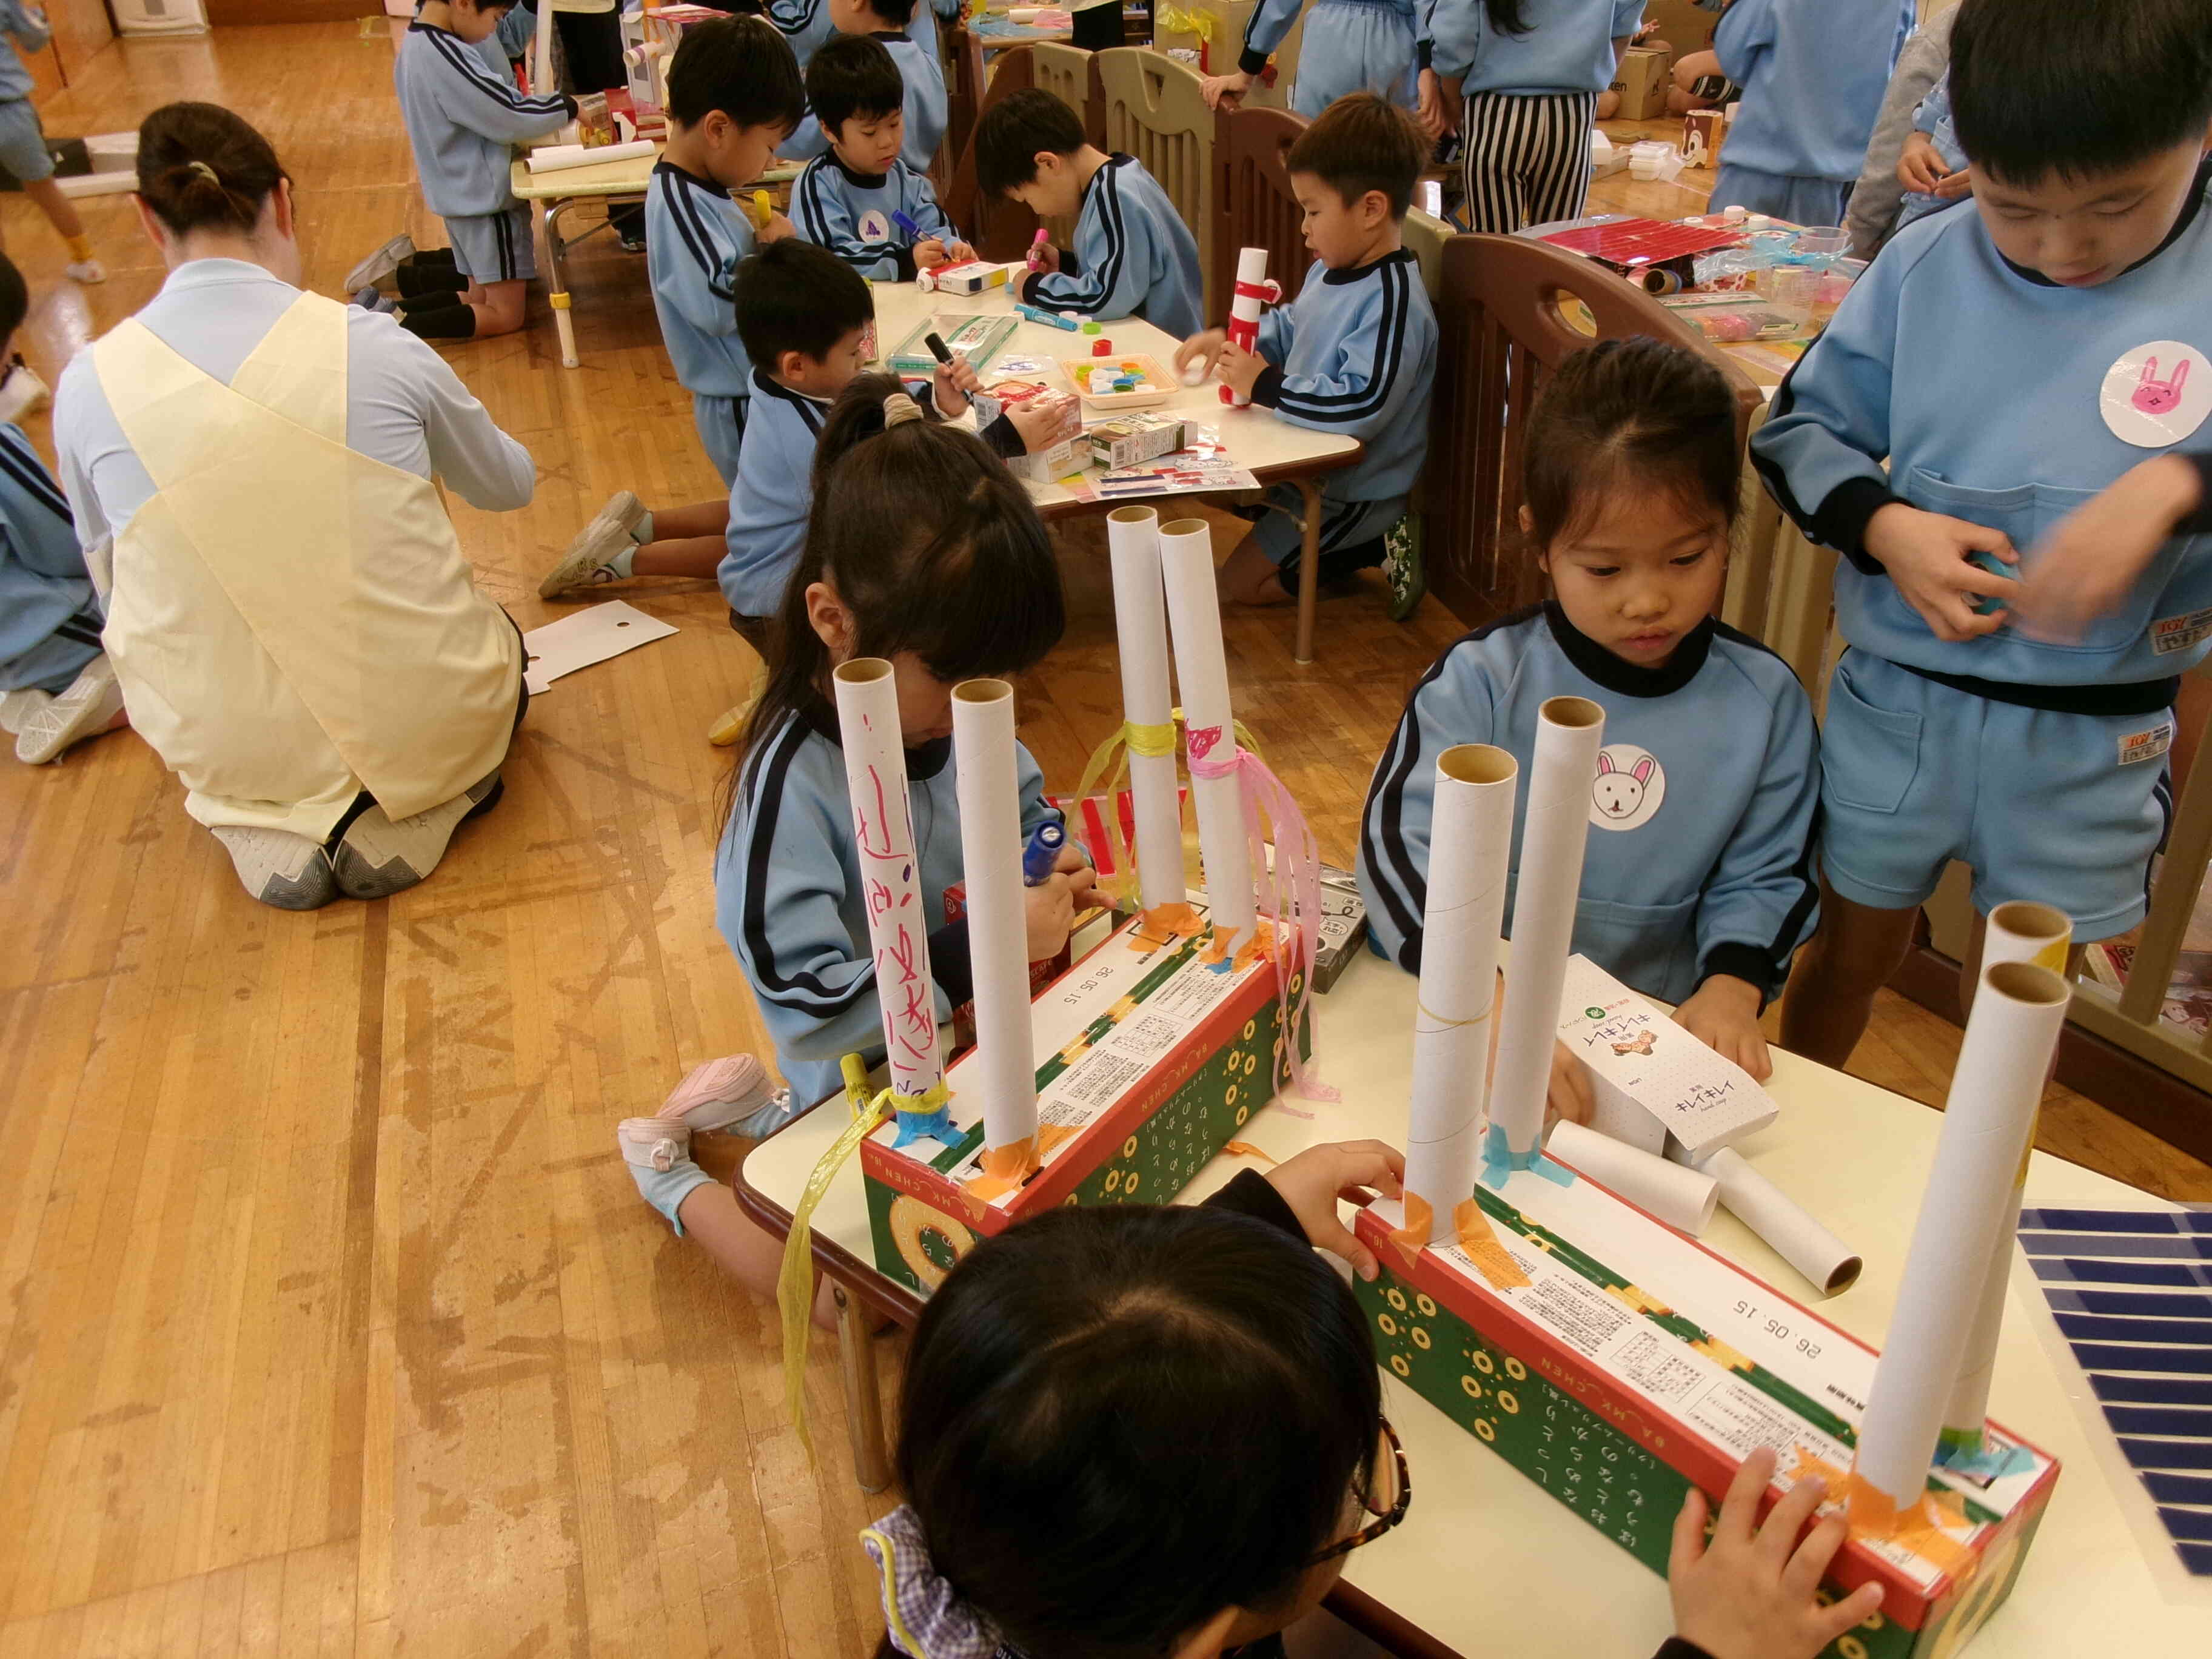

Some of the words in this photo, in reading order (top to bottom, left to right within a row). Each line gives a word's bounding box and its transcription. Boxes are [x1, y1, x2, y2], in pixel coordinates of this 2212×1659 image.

[1063, 966, 1114, 1005] 26.05.15
[1583, 1013, 1651, 1047] キレイキレイ
[1675, 1080, 1735, 1112] キレイキレイ
[1733, 1301, 1822, 1359] 26.05.15
